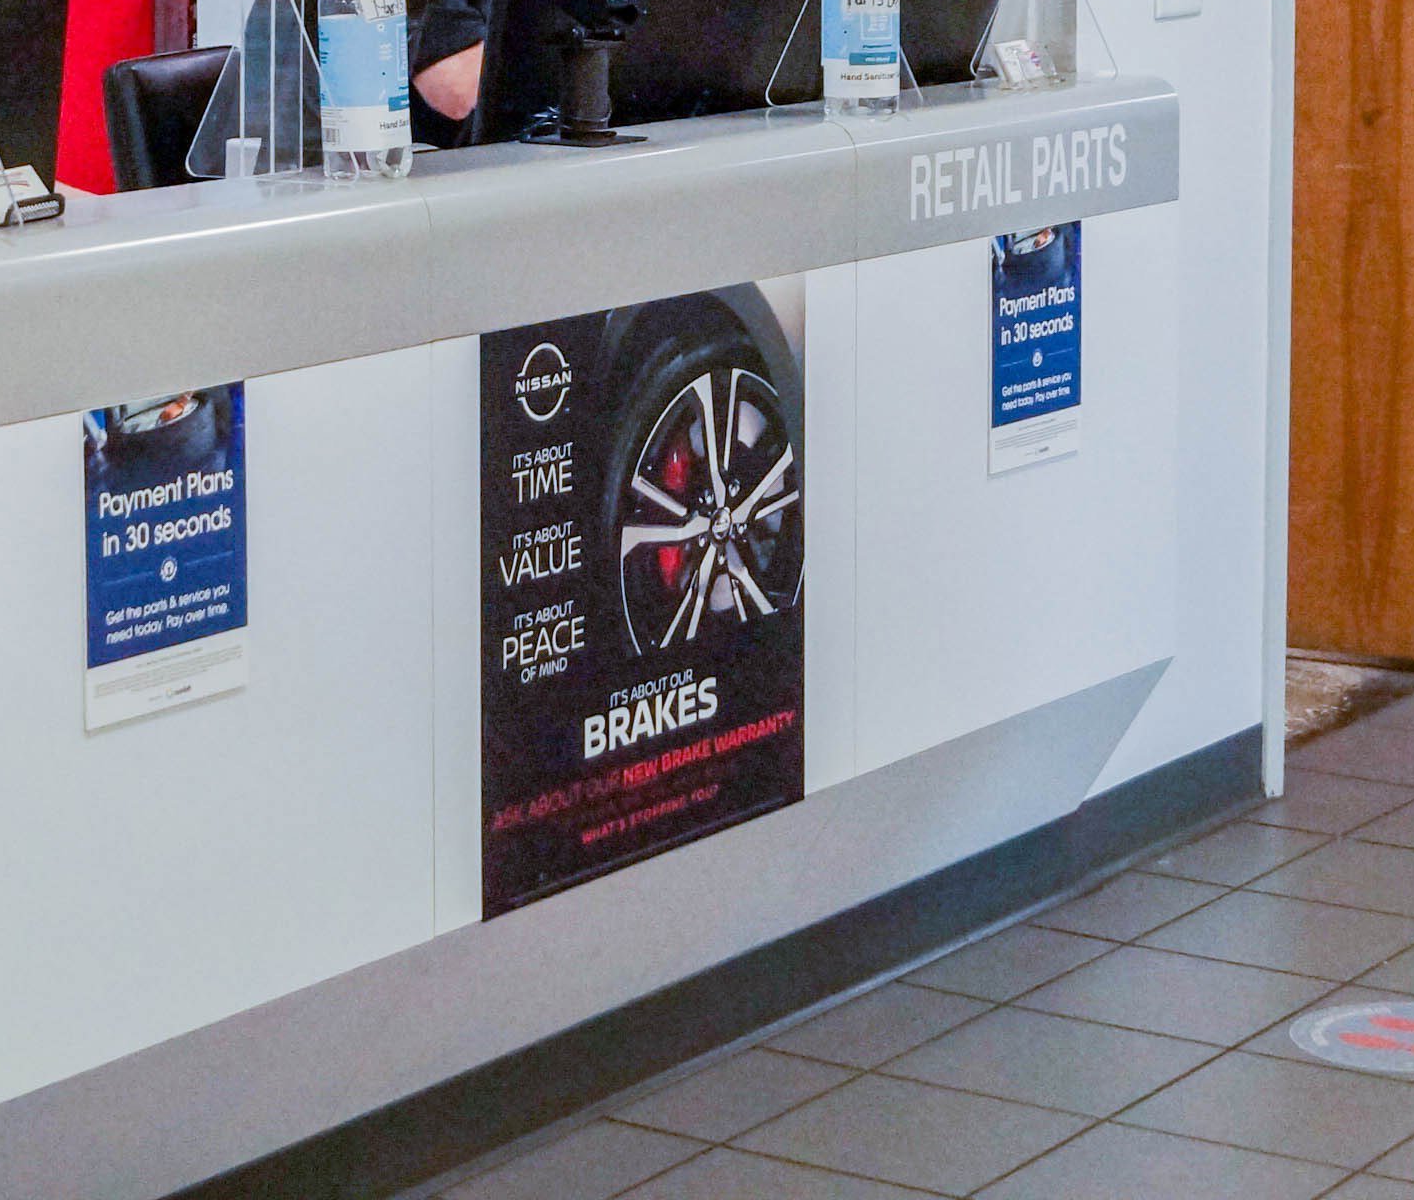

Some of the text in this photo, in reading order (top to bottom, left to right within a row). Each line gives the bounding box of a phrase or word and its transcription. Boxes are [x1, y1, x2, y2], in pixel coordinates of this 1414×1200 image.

[841, 72, 862, 80] Hand
[379, 120, 398, 130] Hand
[910, 122, 1127, 222] RETAIL PARTS
[999, 286, 1075, 318] Payment Plans
[1001, 312, 1074, 346] in 30 seconds
[515, 370, 572, 394] NISSAN
[1002, 385, 1013, 397] Get
[513, 442, 574, 468] IT'S ABOUT
[99, 469, 234, 519] Payment Plans
[512, 460, 574, 503] TIME
[103, 504, 232, 558] in 30 seconds
[513, 521, 574, 548] IT'S ABOUT
[500, 536, 582, 587] VALUE
[105, 584, 230, 626] Get the parts & service you
[106, 627, 133, 645] need
[166, 614, 183, 630] Pay
[185, 608, 206, 623] over
[207, 603, 229, 617] time.
[514, 600, 574, 631] IT'S ABOUT
[503, 615, 585, 670] PEACE
[521, 657, 568, 684] OF MIND
[610, 668, 693, 708] IT'S ABOUT OUR
[583, 676, 718, 760] BRAKES
[622, 759, 659, 787] NEW
[661, 741, 712, 774] BRAKE
[714, 710, 796, 754] WARRANTY
